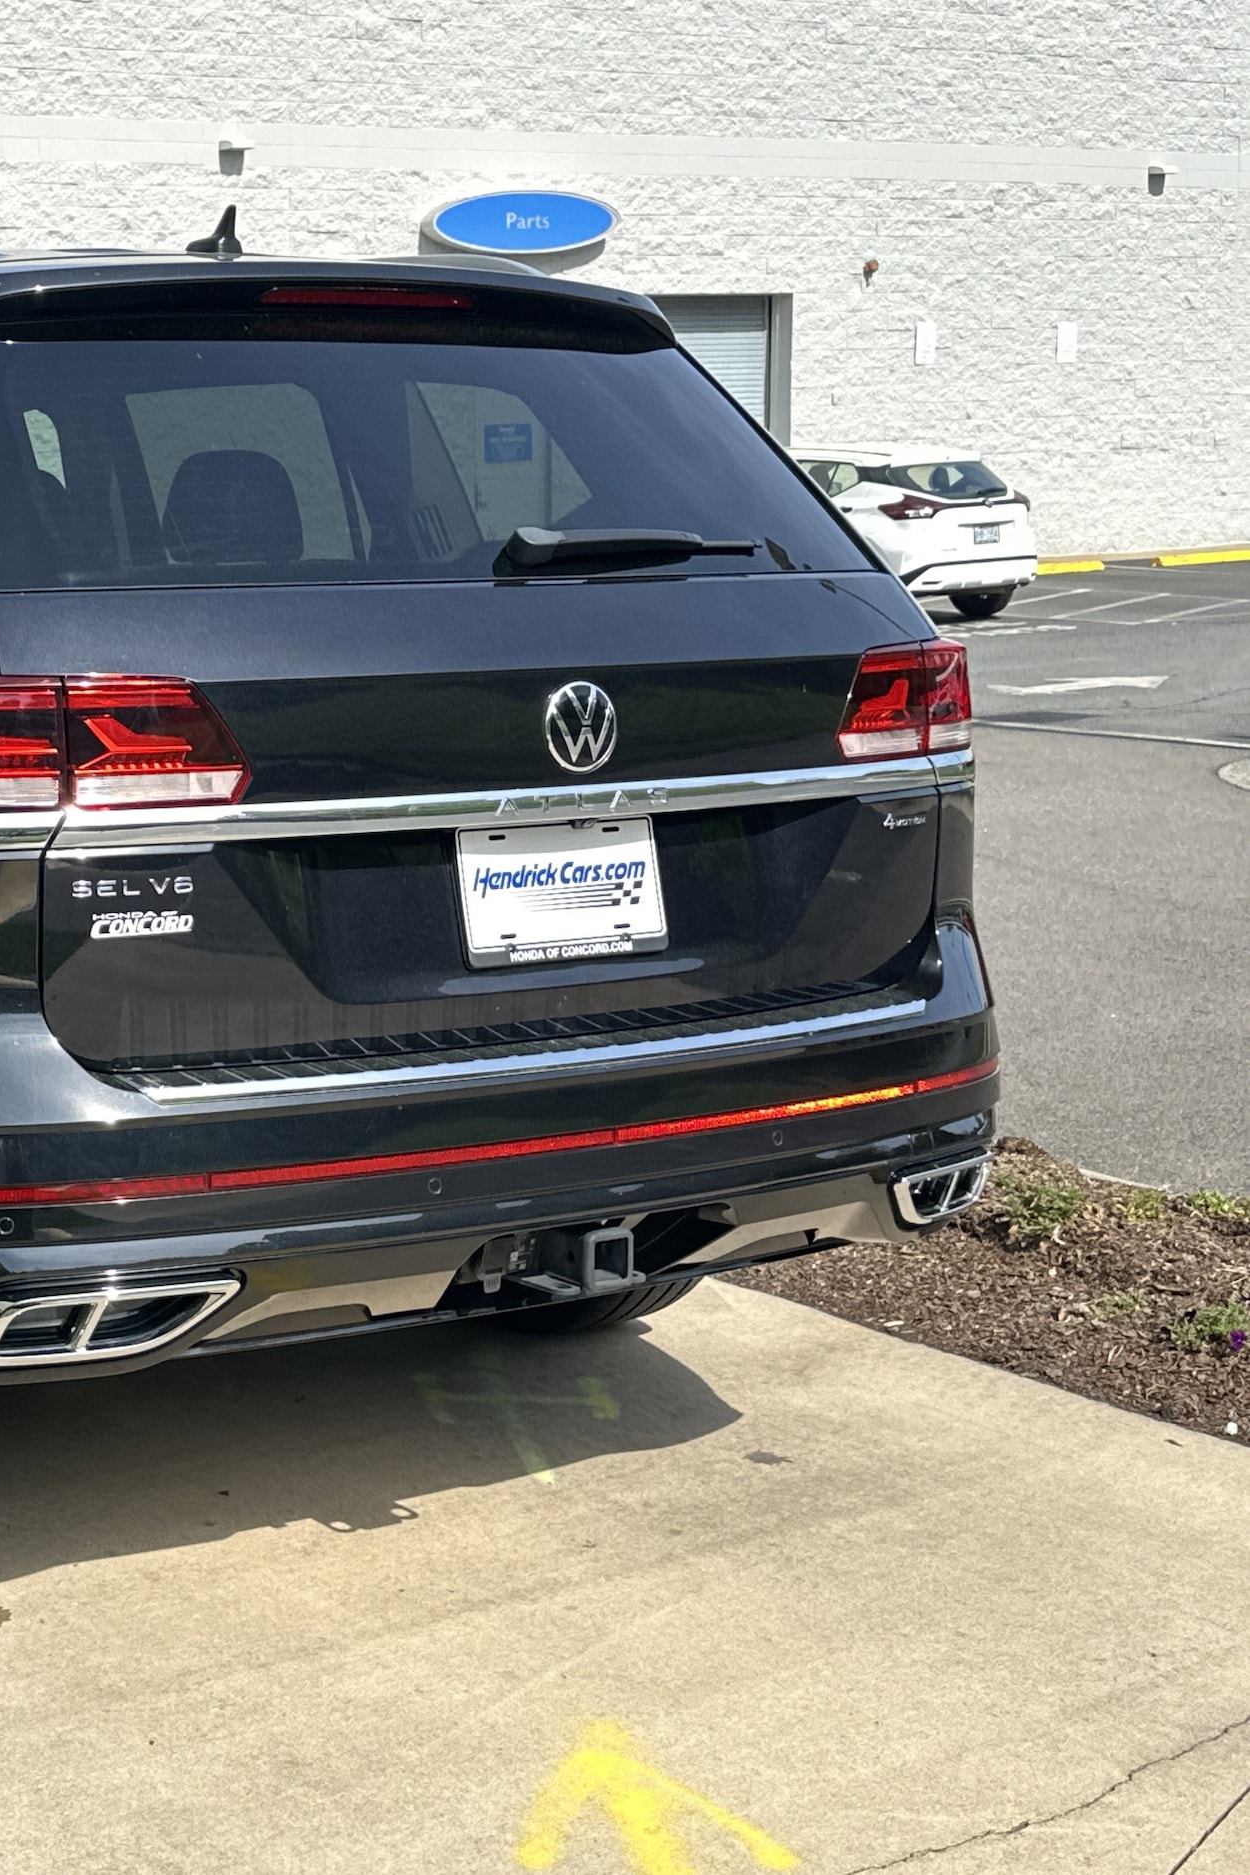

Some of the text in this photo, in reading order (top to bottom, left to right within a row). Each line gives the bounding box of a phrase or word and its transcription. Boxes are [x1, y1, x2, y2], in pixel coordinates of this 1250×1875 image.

[506, 212, 550, 230] Parts
[495, 787, 668, 817] ATLAS
[71, 876, 194, 899] SEL V6
[90, 914, 194, 939] CONCORD
[92, 911, 158, 921] HONDA
[509, 940, 633, 962] HONDA OF CONCORD.COM
